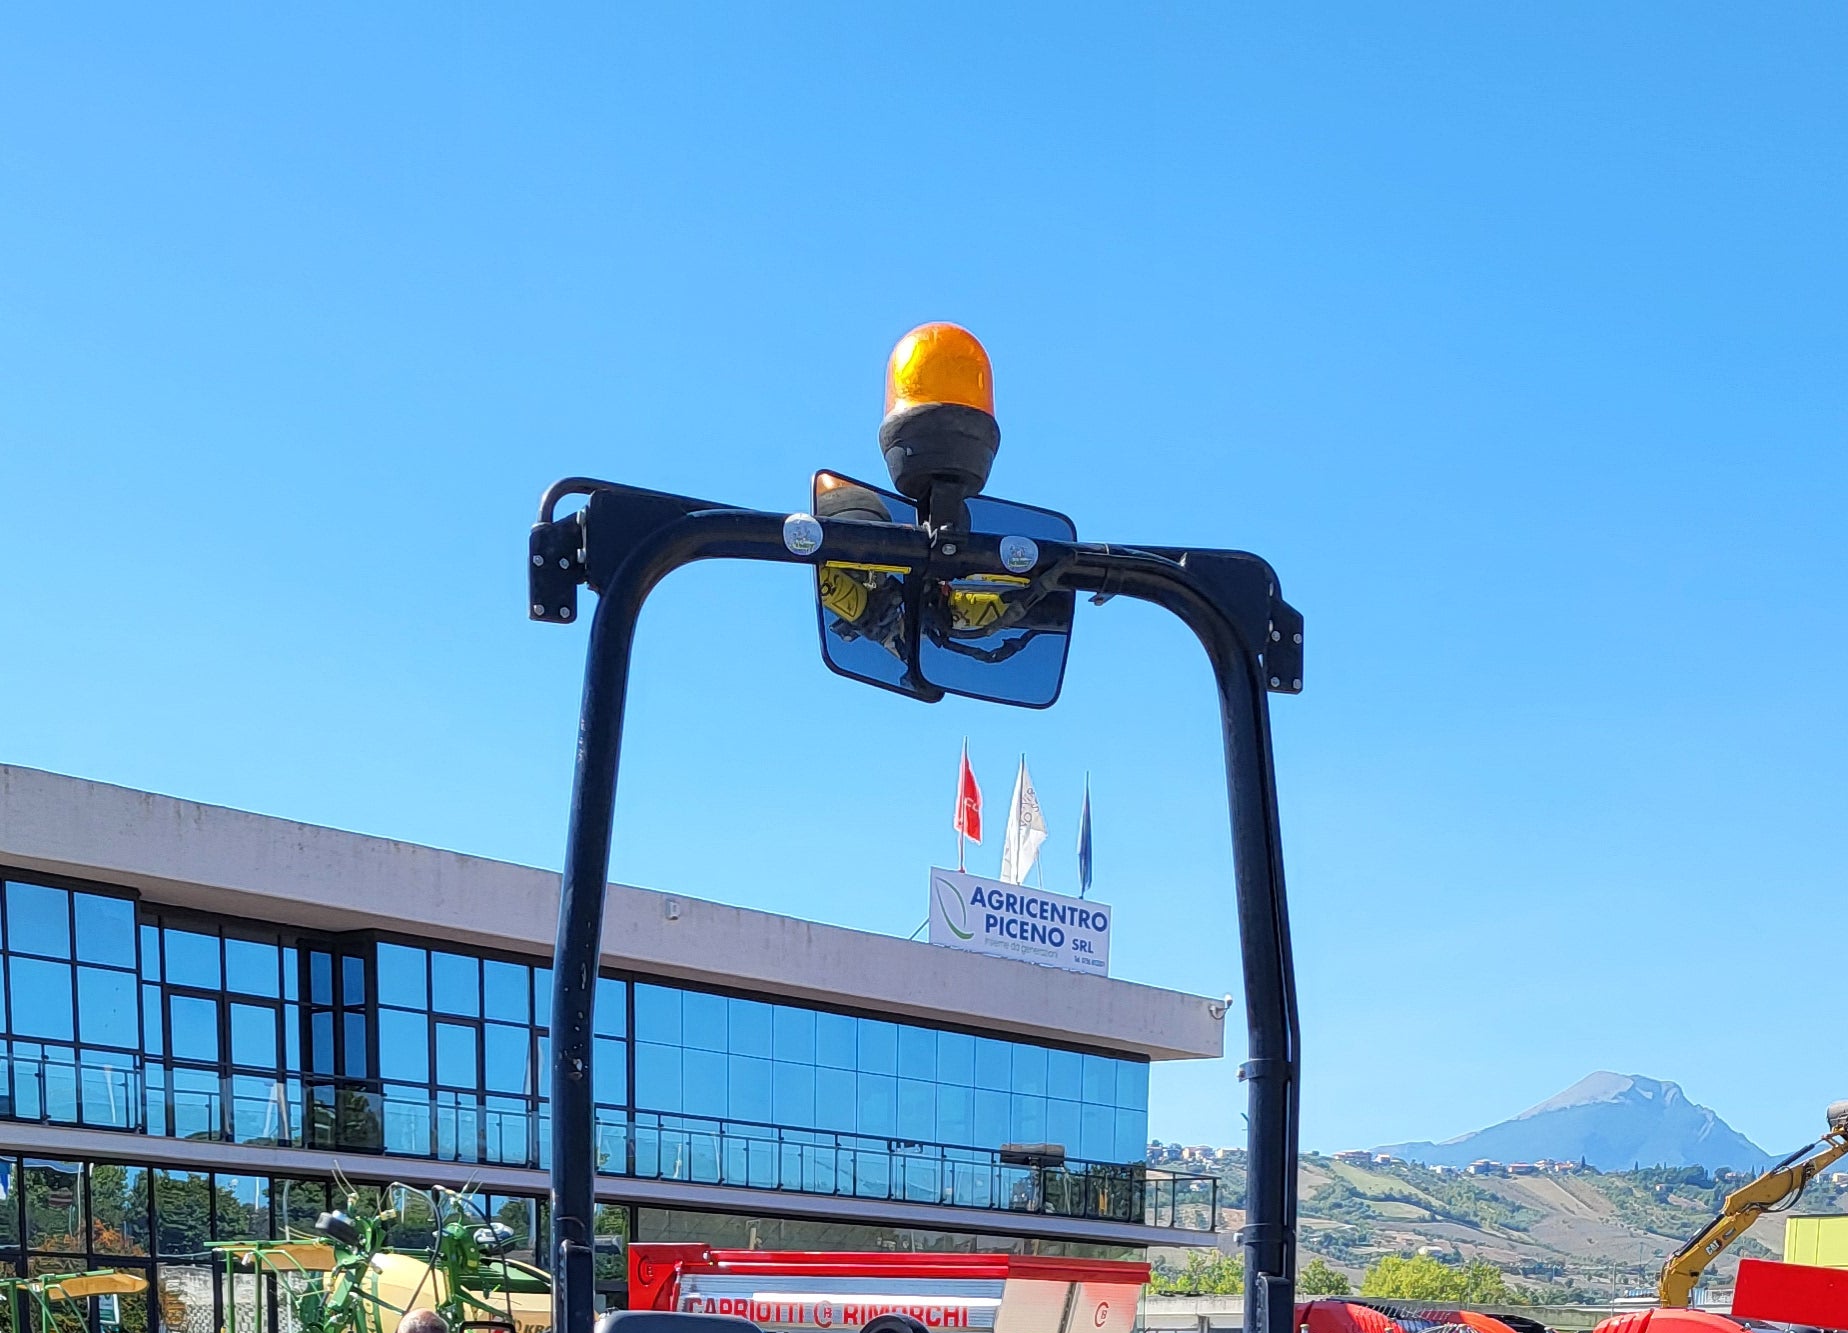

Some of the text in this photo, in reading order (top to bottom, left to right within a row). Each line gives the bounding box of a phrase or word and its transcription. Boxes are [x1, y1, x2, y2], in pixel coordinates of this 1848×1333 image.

[970, 886, 1108, 932] AGRICENTRO
[985, 913, 1094, 954] PICENO SRL
[1706, 1239, 1720, 1256] CAT
